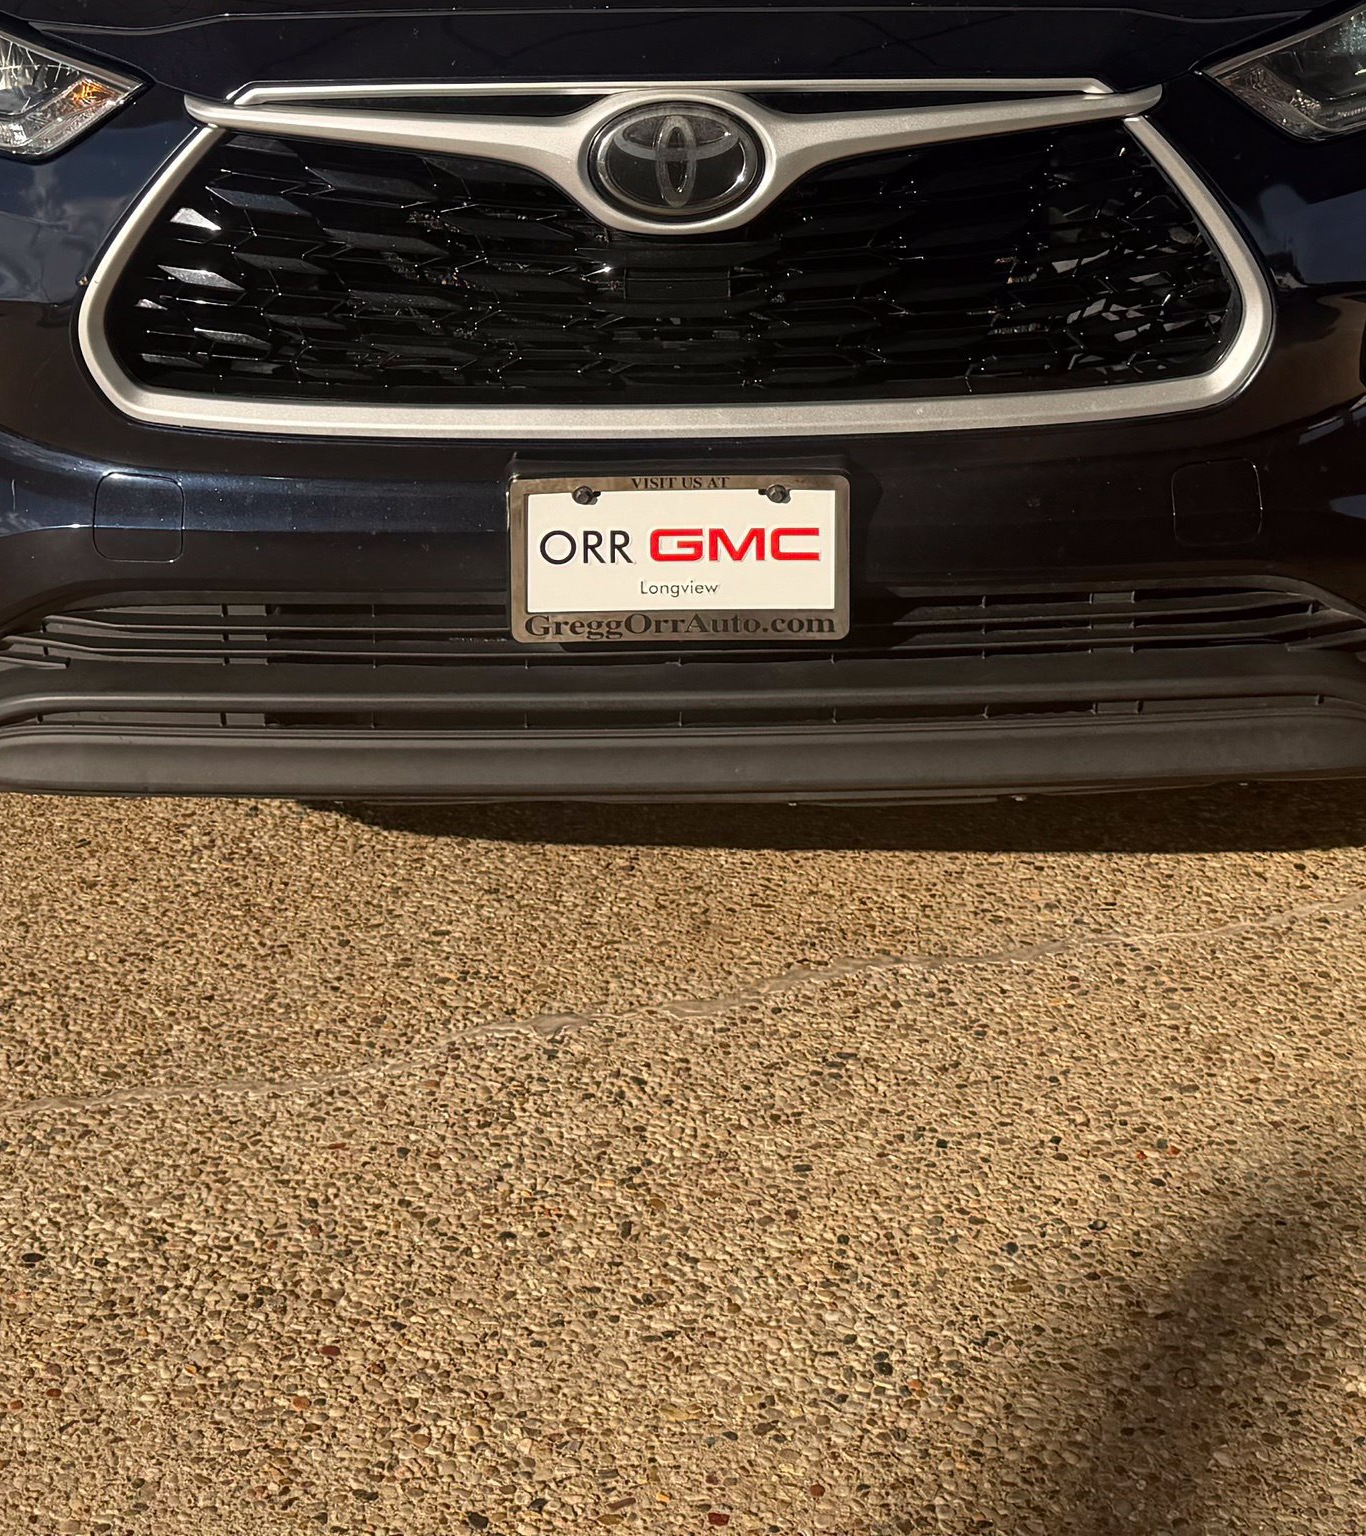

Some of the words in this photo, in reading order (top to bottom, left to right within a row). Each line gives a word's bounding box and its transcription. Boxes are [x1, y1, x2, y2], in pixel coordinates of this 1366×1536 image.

[630, 476, 677, 490] VISIT
[680, 476, 702, 490] US
[702, 476, 730, 489] AT
[539, 529, 634, 566] ORR
[649, 527, 822, 562] GMC
[640, 579, 720, 599] Longview
[524, 611, 837, 641] GreggOrrAuto.com
